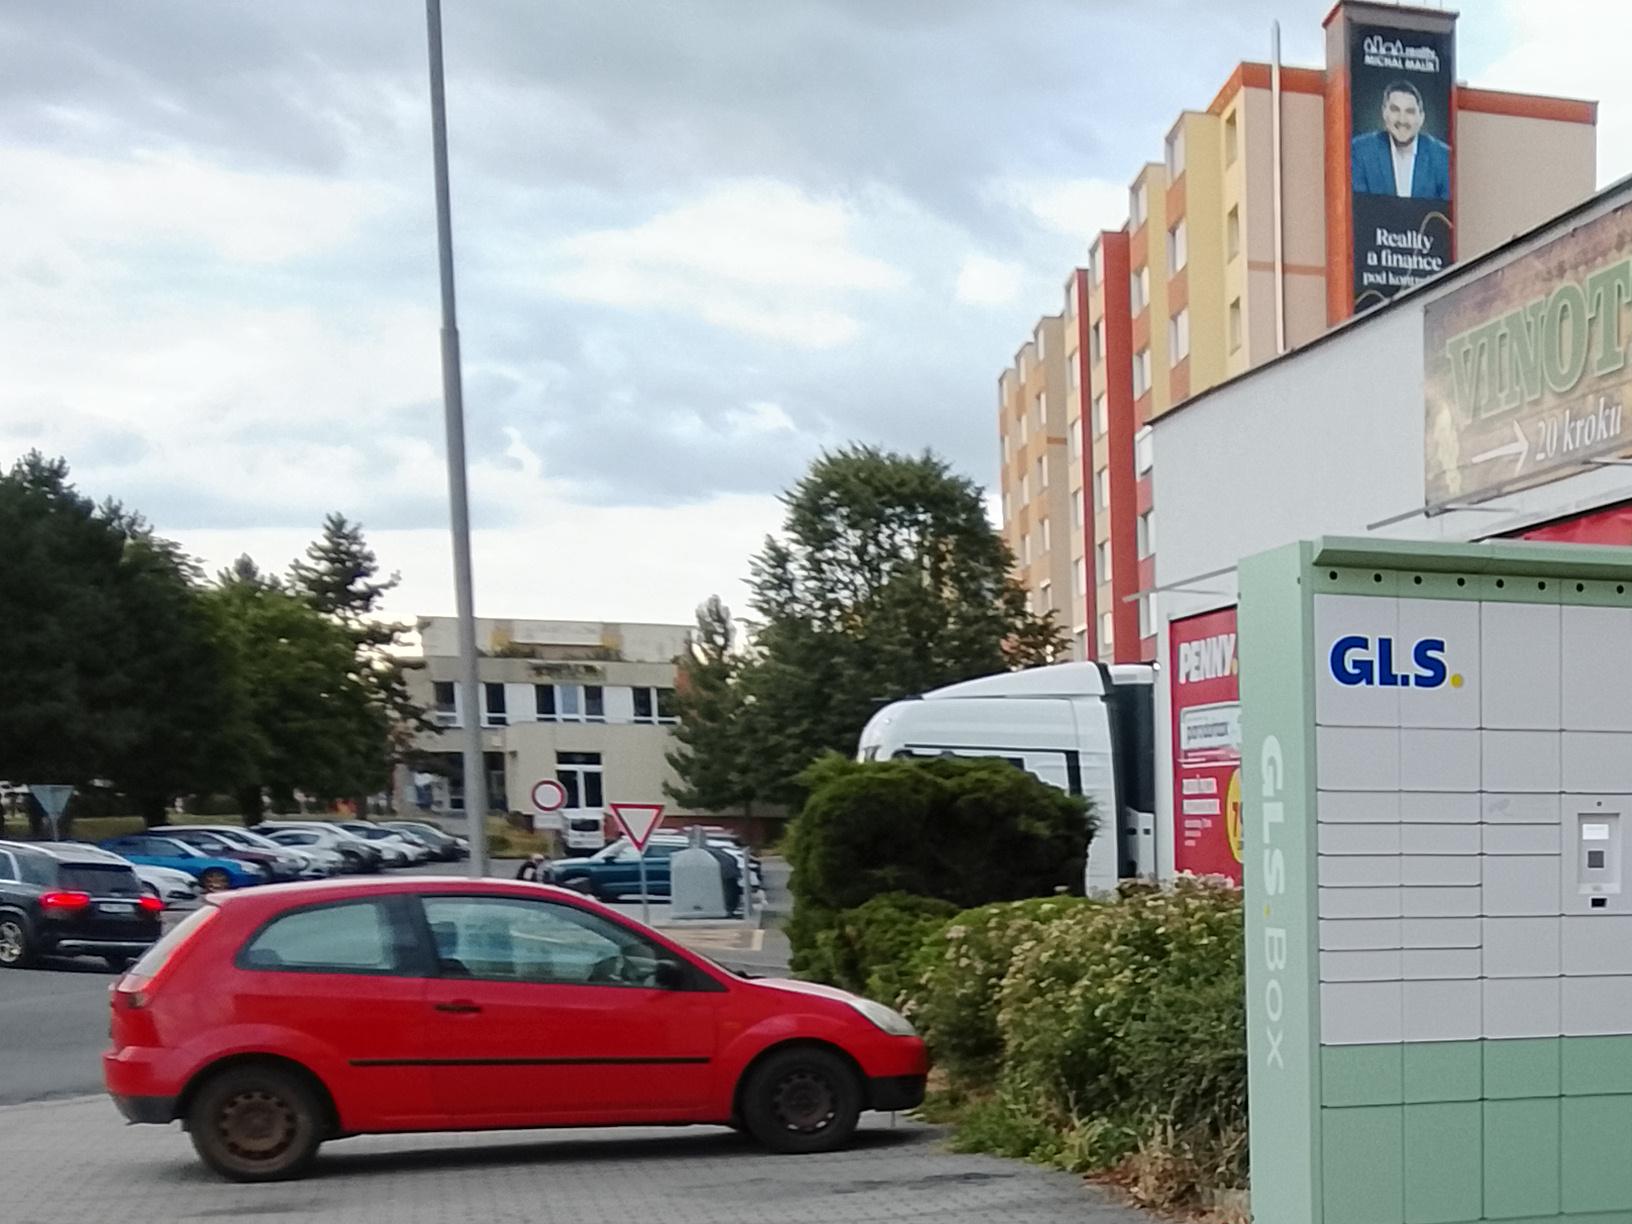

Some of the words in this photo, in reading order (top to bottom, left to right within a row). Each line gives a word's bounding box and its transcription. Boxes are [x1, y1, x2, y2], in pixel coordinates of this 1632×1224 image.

[1376, 228, 1433, 254] Reality
[1366, 250, 1378, 266] a
[1381, 249, 1442, 271] finance
[1179, 633, 1236, 684] PENNY
